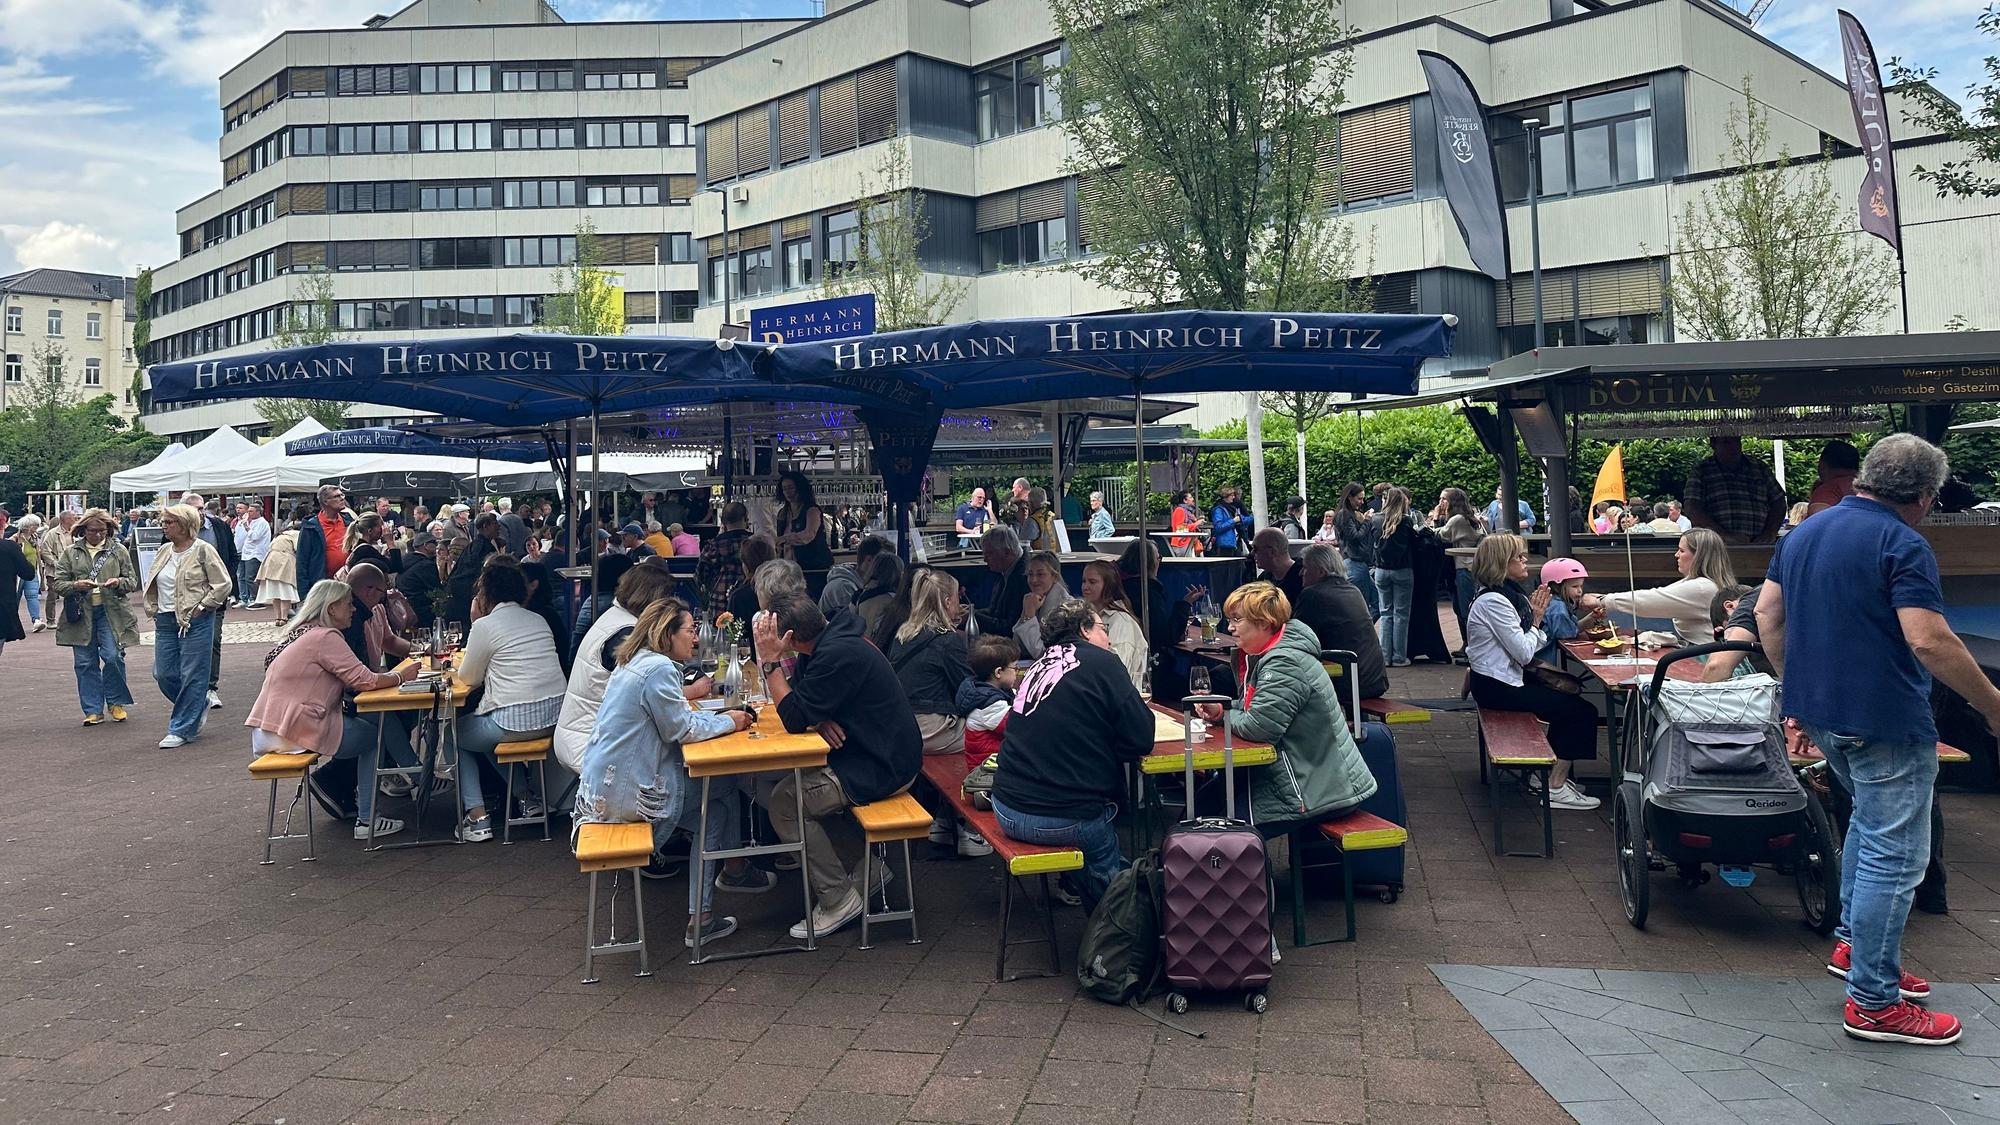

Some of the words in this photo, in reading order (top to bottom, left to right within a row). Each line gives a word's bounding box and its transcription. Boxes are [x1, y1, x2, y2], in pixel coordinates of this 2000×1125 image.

[760, 307, 861, 329] HERMANN
[786, 321, 862, 339] HEINRICH
[832, 335, 1017, 372] HERMANN
[1045, 321, 1244, 353] HEINRICH
[1269, 317, 1383, 351] PEITZ
[193, 357, 354, 390] HERMANN
[380, 345, 552, 375] HEINRICH
[573, 342, 669, 373] PEITZ
[1902, 368, 1954, 380] Weingut
[1871, 383, 1936, 396] Weinstube
[291, 437, 329, 451] HERMANN
[332, 432, 372, 446] HEINRICH
[374, 431, 397, 445] PEITZ
[1745, 798, 1788, 809] Qeridoo
